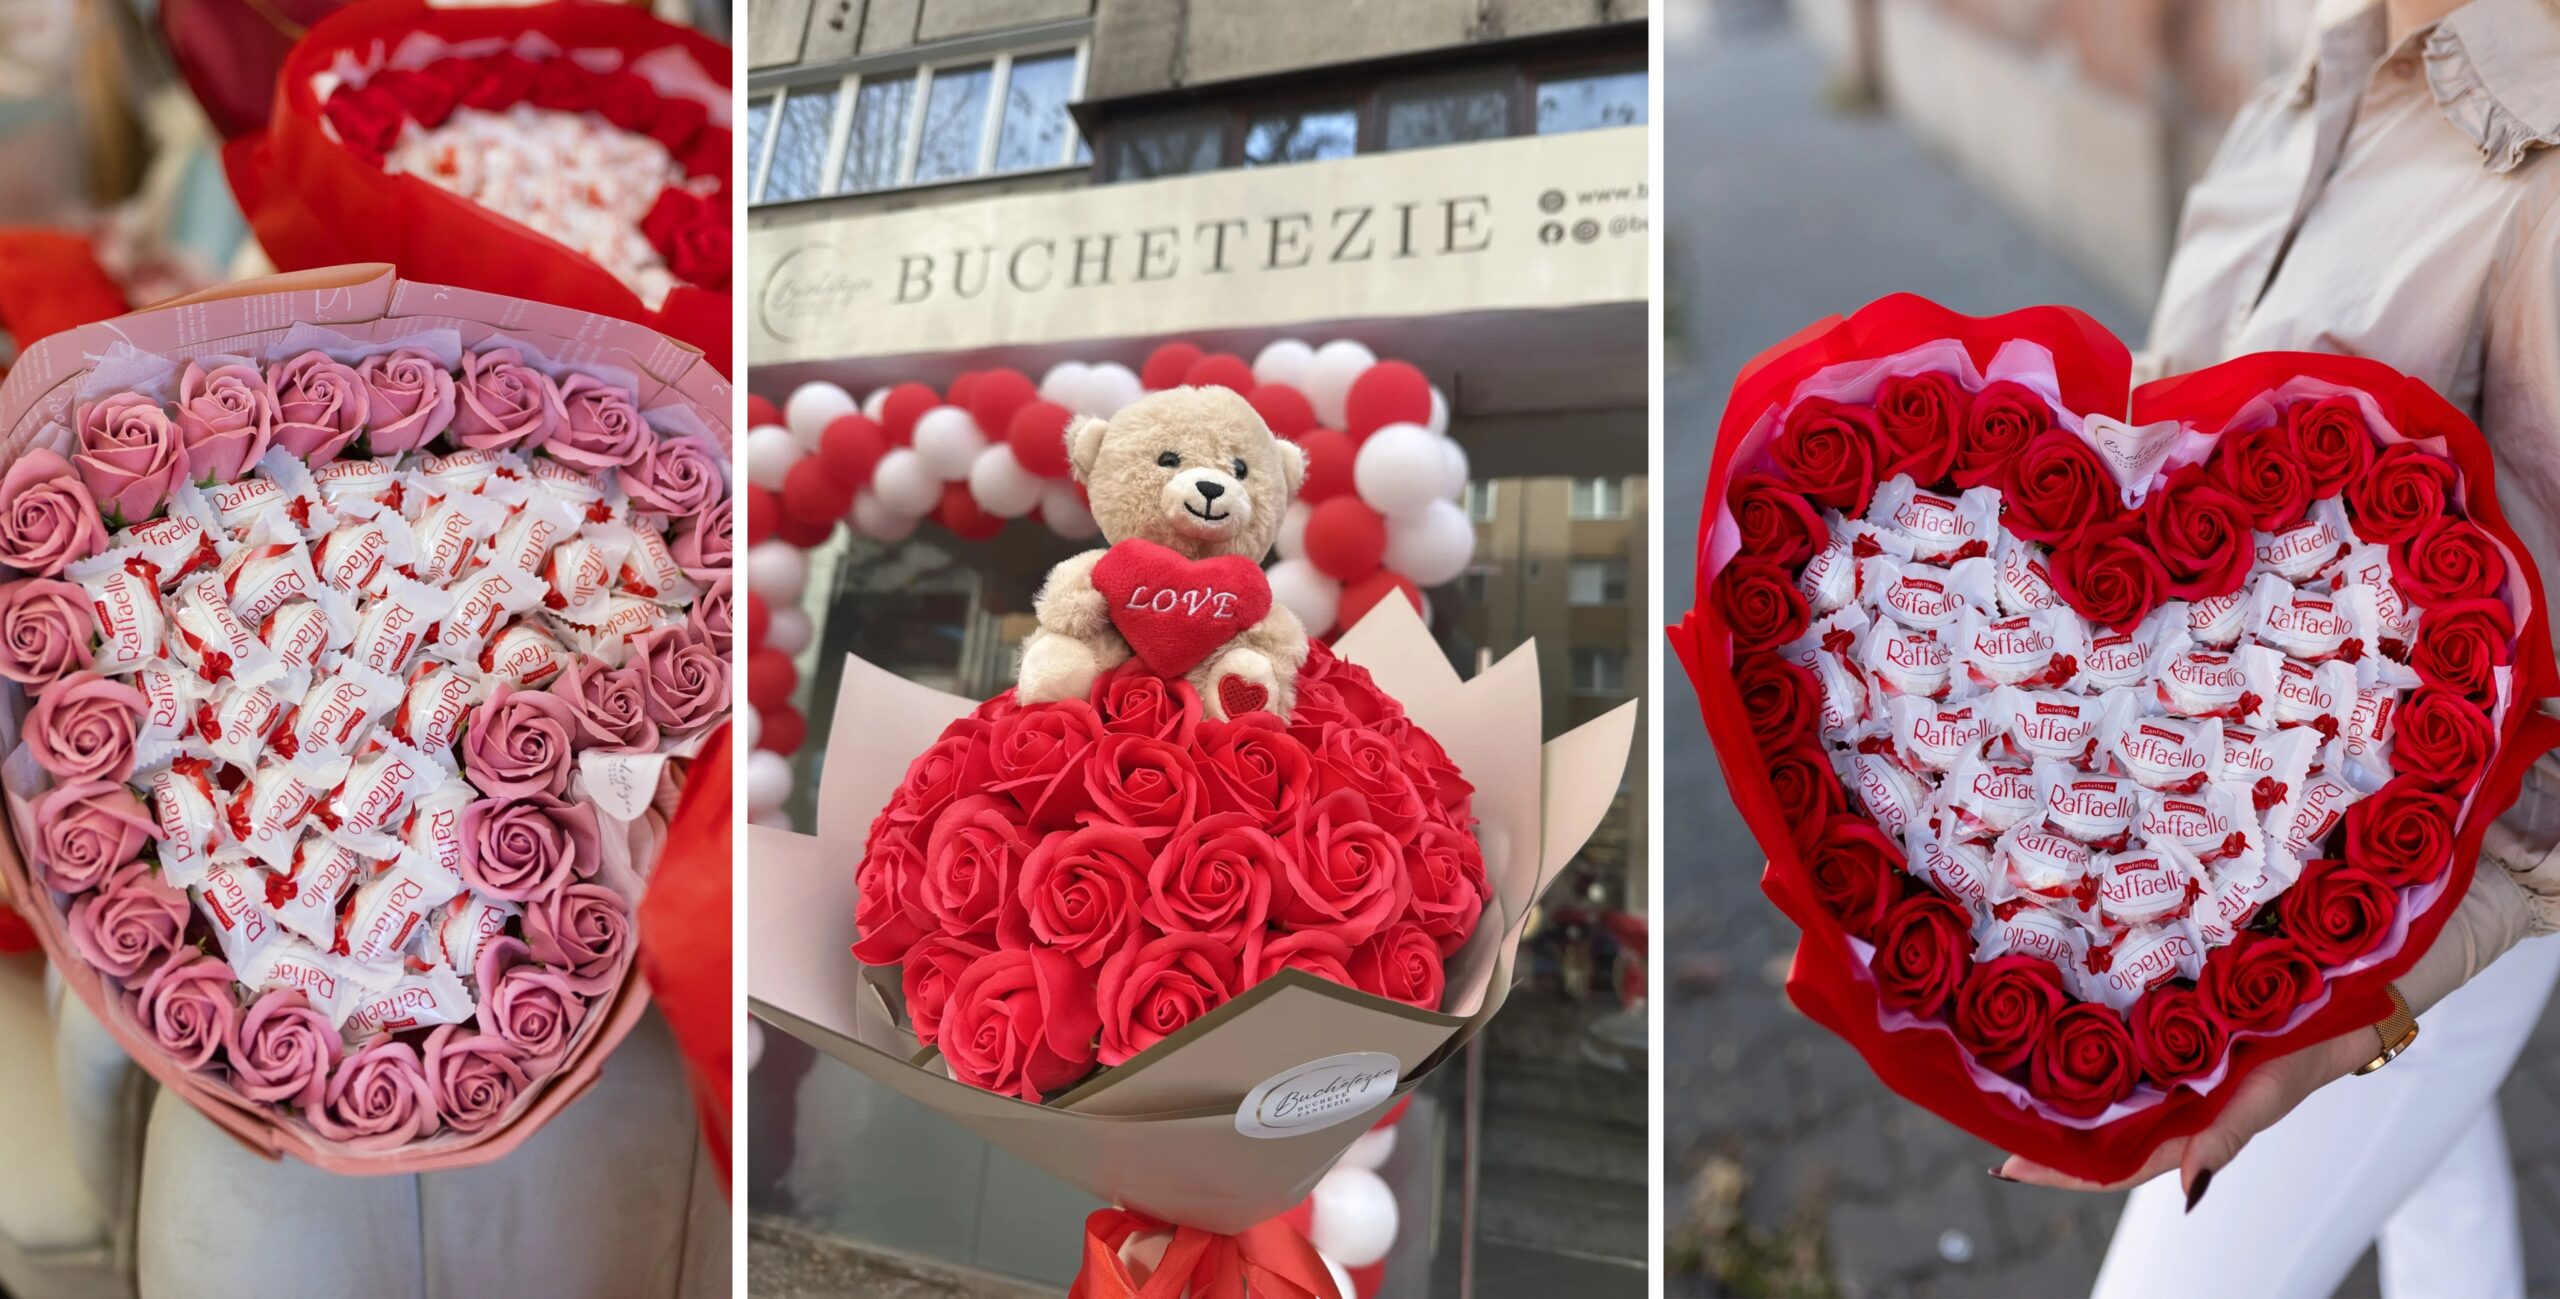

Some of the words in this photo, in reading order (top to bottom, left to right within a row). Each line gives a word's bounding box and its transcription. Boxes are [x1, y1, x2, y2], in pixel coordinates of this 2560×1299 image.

[895, 195, 1493, 305] BUCHETEZIE
[314, 459, 390, 484] Raffaell
[213, 472, 282, 514] Raffael
[142, 515, 199, 546] ffaello
[1893, 502, 1976, 537] Raffaello
[332, 530, 389, 592] Raffaell
[518, 520, 557, 572] Raffa
[2256, 523, 2340, 565] Raffaello
[573, 543, 603, 607] affaello
[1804, 534, 1847, 605] affaello
[2004, 549, 2054, 610] Raffael
[104, 573, 142, 662] Raffaello
[197, 577, 249, 659] Raffaello
[238, 569, 305, 628] Raffaell
[443, 574, 513, 646] Raffaello
[1125, 586, 1238, 618] LOVE
[1887, 580, 1965, 617] Raffaello
[2187, 586, 2246, 631] Raffae
[281, 609, 332, 671] affaello
[368, 603, 414, 674] Raffael
[600, 601, 658, 640] affaell
[2266, 605, 2353, 635] Raffaello
[498, 643, 553, 677] ffaell
[1886, 638, 1953, 668] Raffael
[1974, 631, 2054, 657] Raffaello
[2168, 653, 2246, 687] Raffaello
[151, 672, 177, 728] Raffa
[2038, 704, 2077, 717] Confetteria
[2277, 674, 2332, 709] faello
[227, 686, 272, 745] ffaello
[304, 682, 367, 754] Raffaello
[422, 675, 472, 755] Raffaello
[1914, 718, 2000, 748] Raffaello
[2142, 726, 2181, 743] Confetteria
[2224, 729, 2253, 743] nfetteria
[2121, 731, 2206, 769] Raffaello
[2223, 741, 2273, 772] aello
[348, 759, 415, 835] Raffaello
[1855, 756, 1907, 840] Raffaello
[1973, 773, 2035, 801] Raffae
[2050, 784, 2134, 819] Raffaello
[152, 772, 195, 863] Raffaello
[257, 777, 306, 842] affaello
[2142, 811, 2228, 837] Raffaello
[2165, 802, 2205, 815] Confetteria
[432, 810, 459, 875] Raffae
[302, 845, 354, 908] affaello
[1924, 842, 1986, 912] Raffaello
[2101, 870, 2187, 903] Raffaello
[2117, 860, 2158, 873] Confetteria
[355, 878, 423, 965] Raffaello
[270, 963, 335, 999] Raffae
[2109, 935, 2196, 991] Raffaello
[348, 987, 437, 1031] Raffaello
[1297, 1092, 1349, 1112] BUCHETE
[1297, 1099, 1351, 1118] FANTEZIE
